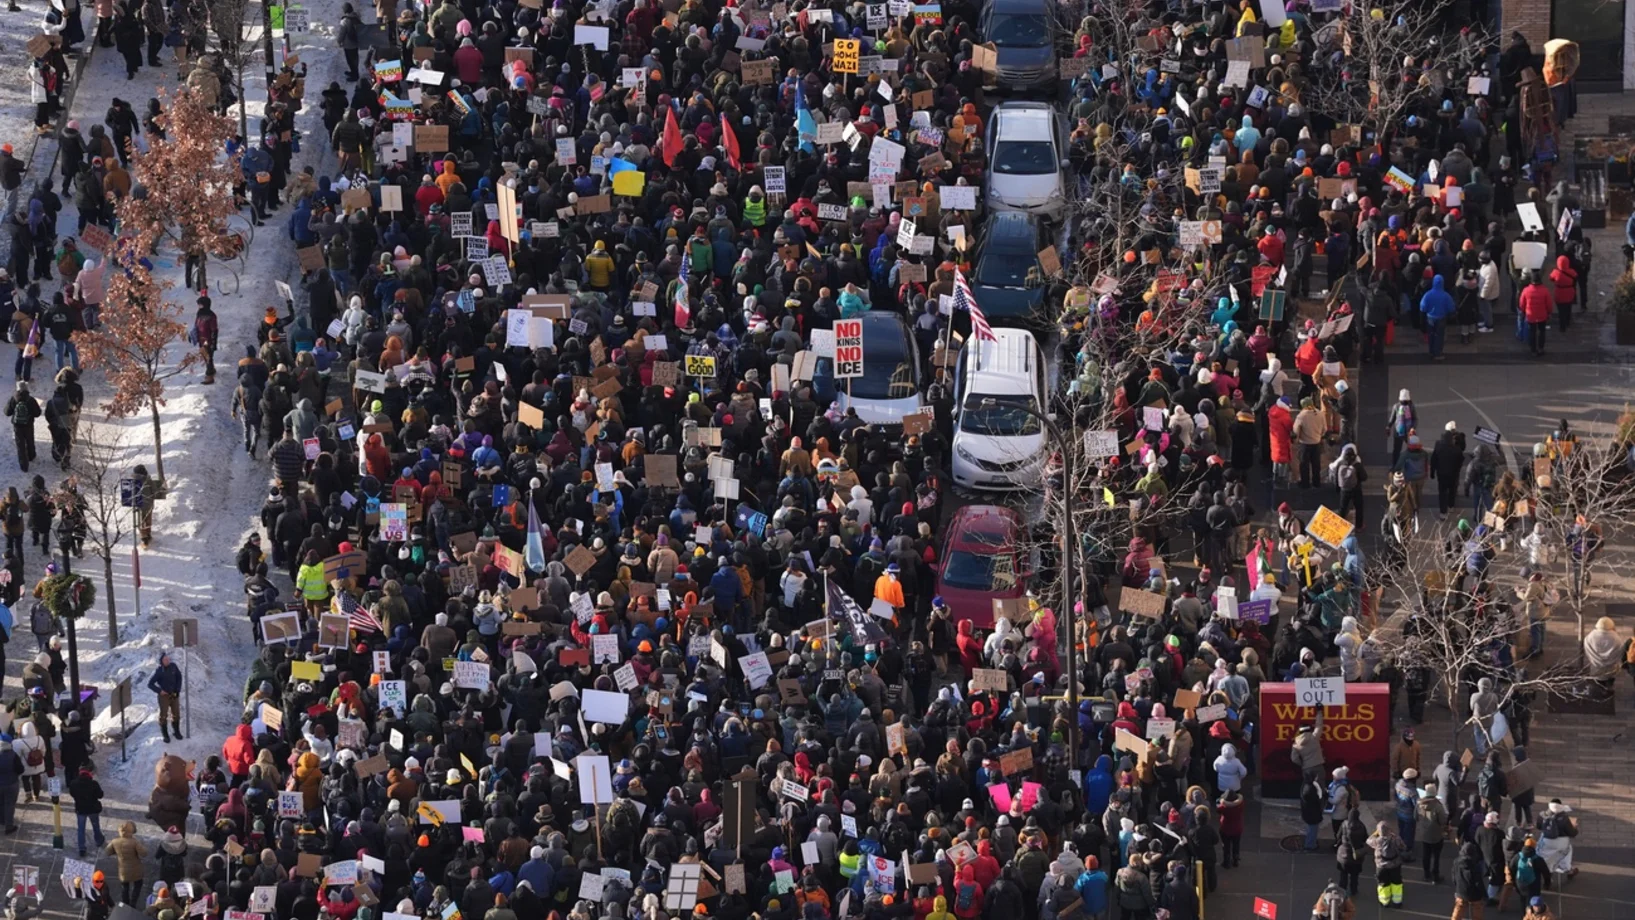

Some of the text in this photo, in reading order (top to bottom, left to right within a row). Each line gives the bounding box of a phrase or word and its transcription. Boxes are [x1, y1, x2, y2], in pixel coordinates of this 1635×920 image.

[870, 5, 882, 17] ICE
[837, 41, 854, 50] GO
[834, 51, 857, 60] HOME
[834, 60, 856, 70] NAZI
[820, 204, 831, 212] ICE
[836, 322, 860, 338] NO
[836, 338, 860, 346] KINGS
[836, 346, 861, 362] NO
[688, 365, 714, 375] GOOD
[837, 362, 861, 374] ICE
[754, 513, 767, 526] ICE
[385, 531, 403, 540] US
[454, 567, 474, 578] ICE
[990, 674, 1005, 683] OUT
[1310, 679, 1327, 688] ICE
[1303, 692, 1335, 703] OUT
[1272, 704, 1375, 721] WELLS
[878, 875, 893, 885] ICE
